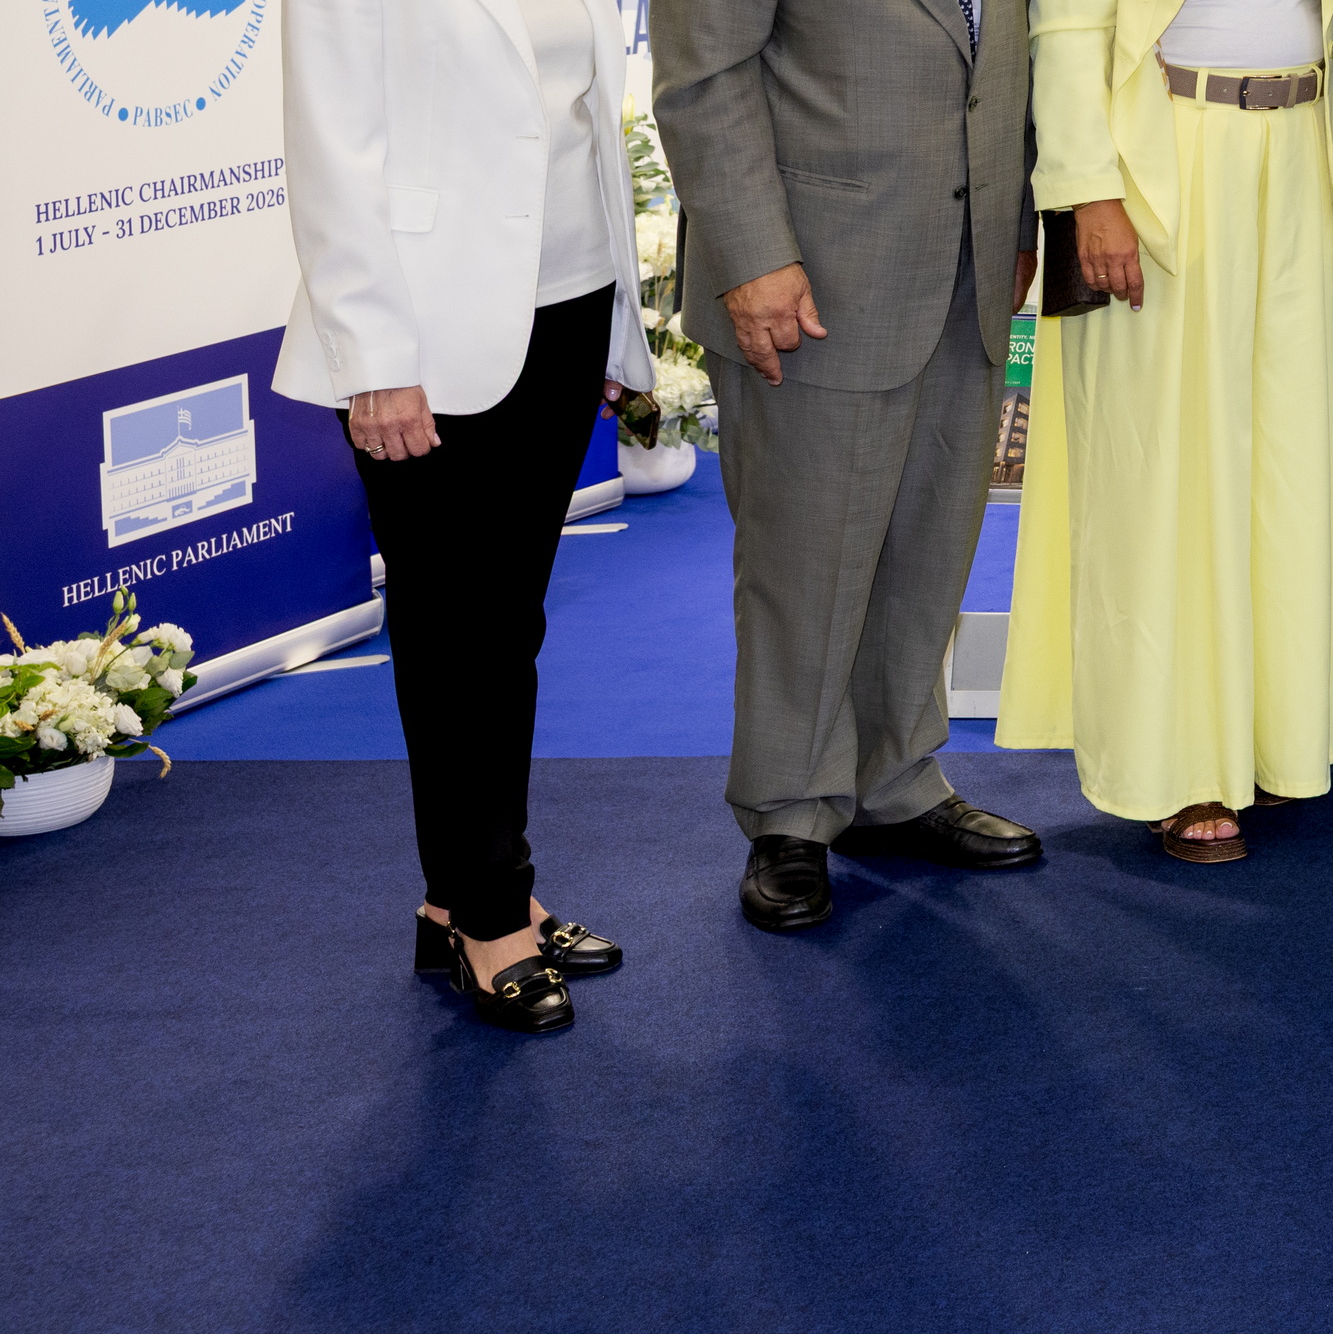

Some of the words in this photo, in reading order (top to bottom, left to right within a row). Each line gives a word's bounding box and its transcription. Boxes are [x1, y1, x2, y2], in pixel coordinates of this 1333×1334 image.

[132, 98, 194, 128] PABSEC
[35, 186, 135, 224] HELLENIC
[139, 157, 286, 204] CHAIRMANSHIP
[36, 235, 44, 256] 1
[49, 225, 97, 254] JULY
[115, 215, 136, 240] 31
[139, 192, 242, 235] DECEMBER
[246, 186, 286, 212] 2026
[62, 555, 167, 607] HELLENIC
[171, 512, 295, 572] PARLIAMENT
